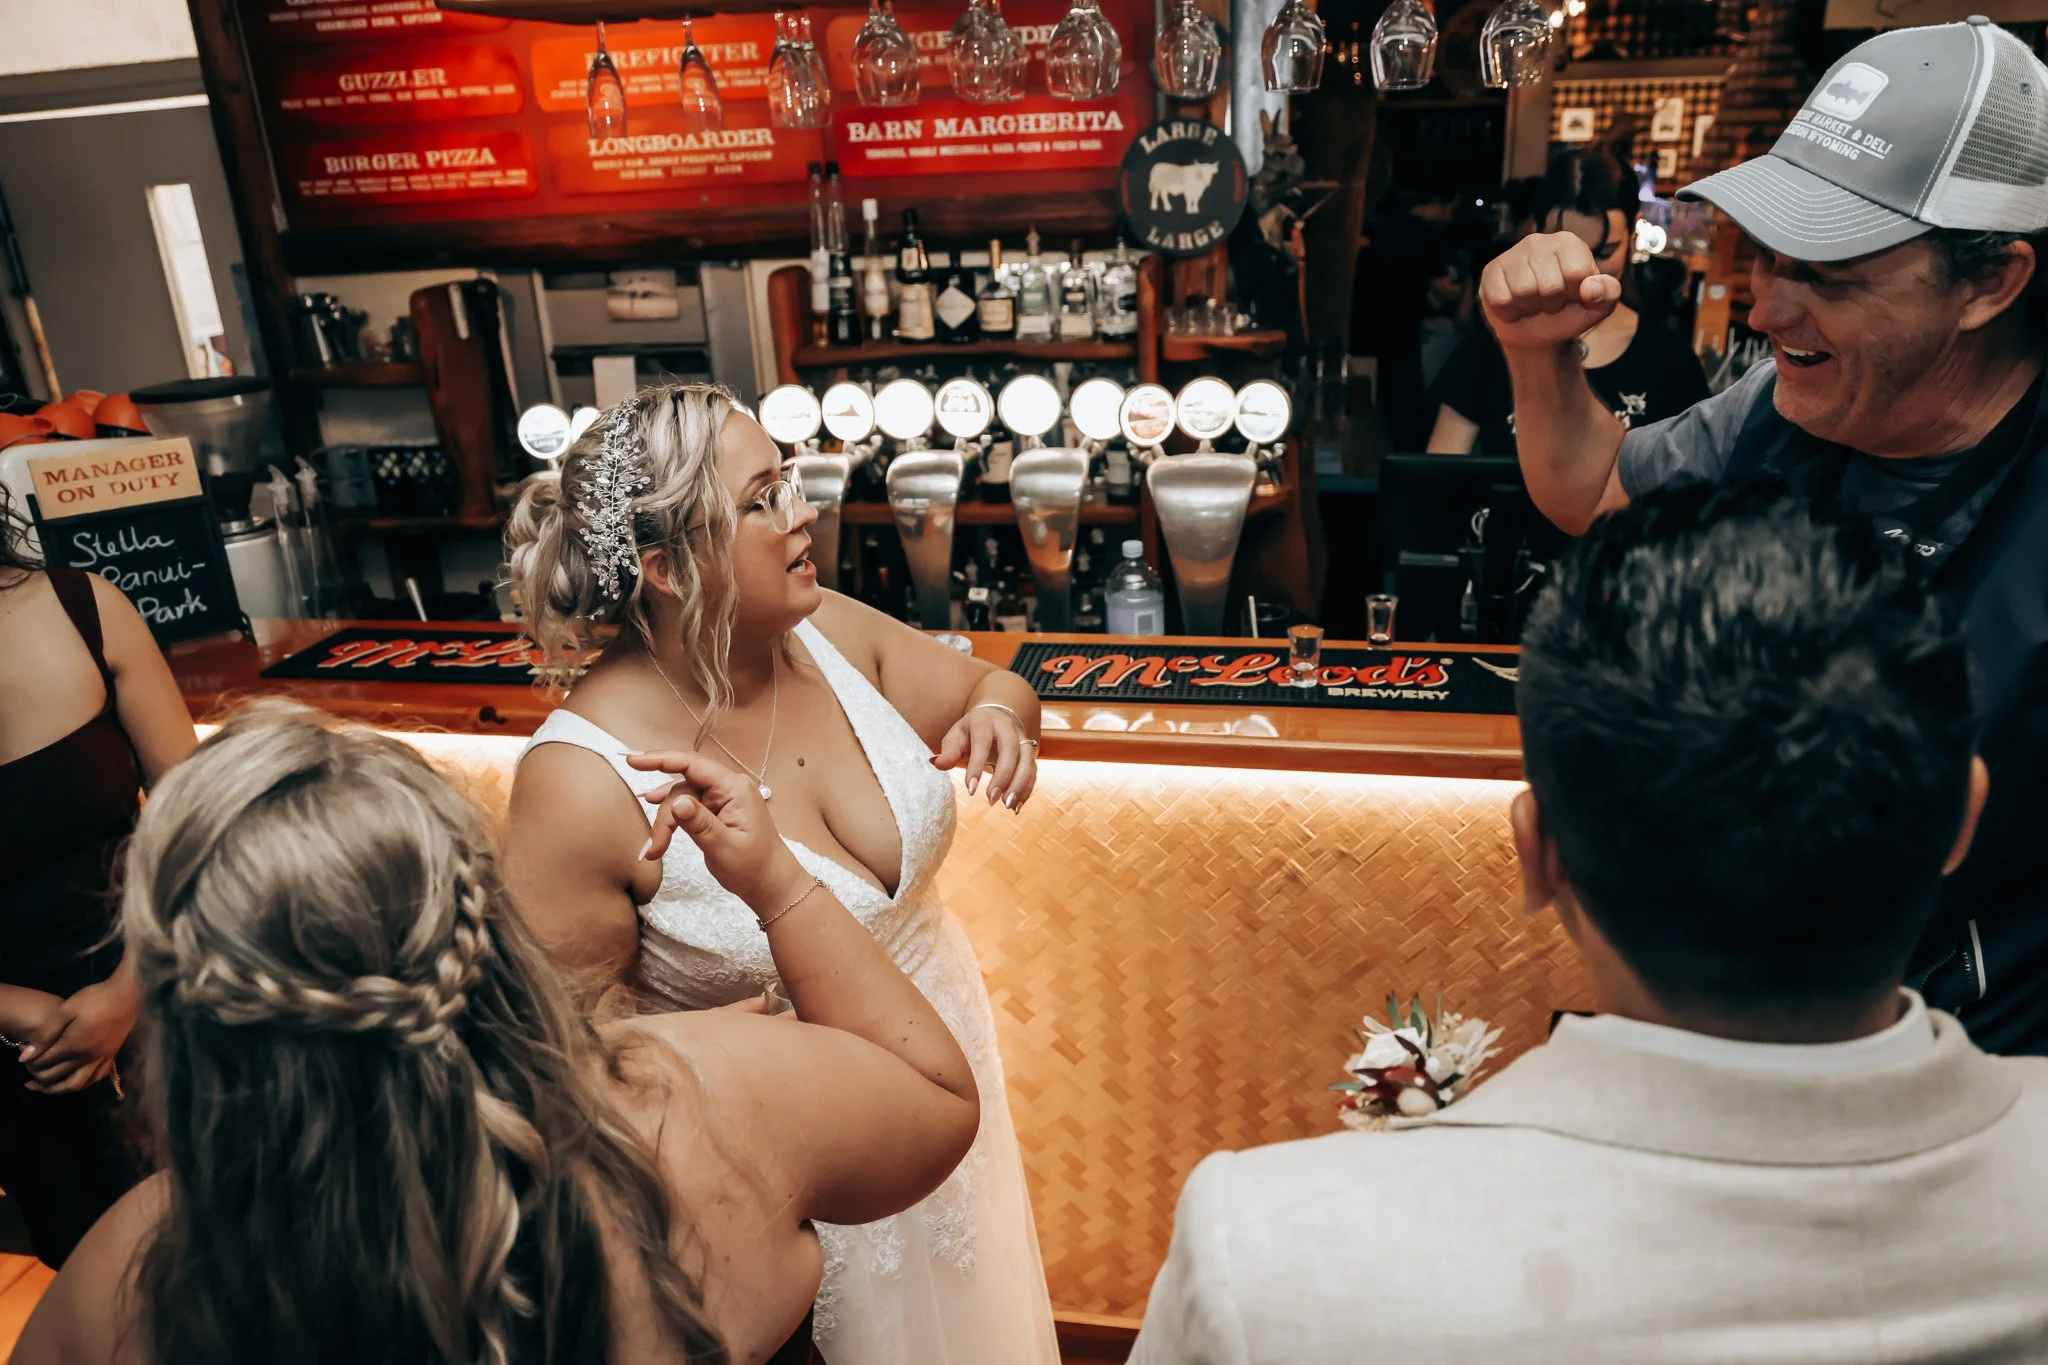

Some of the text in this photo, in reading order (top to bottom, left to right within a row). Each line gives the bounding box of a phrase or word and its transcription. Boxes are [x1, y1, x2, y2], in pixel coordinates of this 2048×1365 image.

[584, 42, 759, 72] FREFITER
[339, 68, 446, 92] GUZZLER
[587, 128, 775, 157] LONGBOARDER
[847, 110, 1124, 143] BARN MARGHERITA
[1139, 121, 1218, 154] LARGE
[1811, 113, 1852, 136] MARKET
[1851, 128, 1863, 141] &
[1862, 134, 1894, 155] DELI
[1807, 128, 1861, 160] WYOMING
[324, 147, 496, 174] BURGER PIZZA
[1146, 220, 1224, 250] LARGE
[43, 451, 184, 486] MANAGER
[57, 471, 181, 504] ON DUTY
[69, 526, 175, 568] Stella
[137, 587, 208, 624] Park
[1327, 687, 1451, 700] BREWERY
